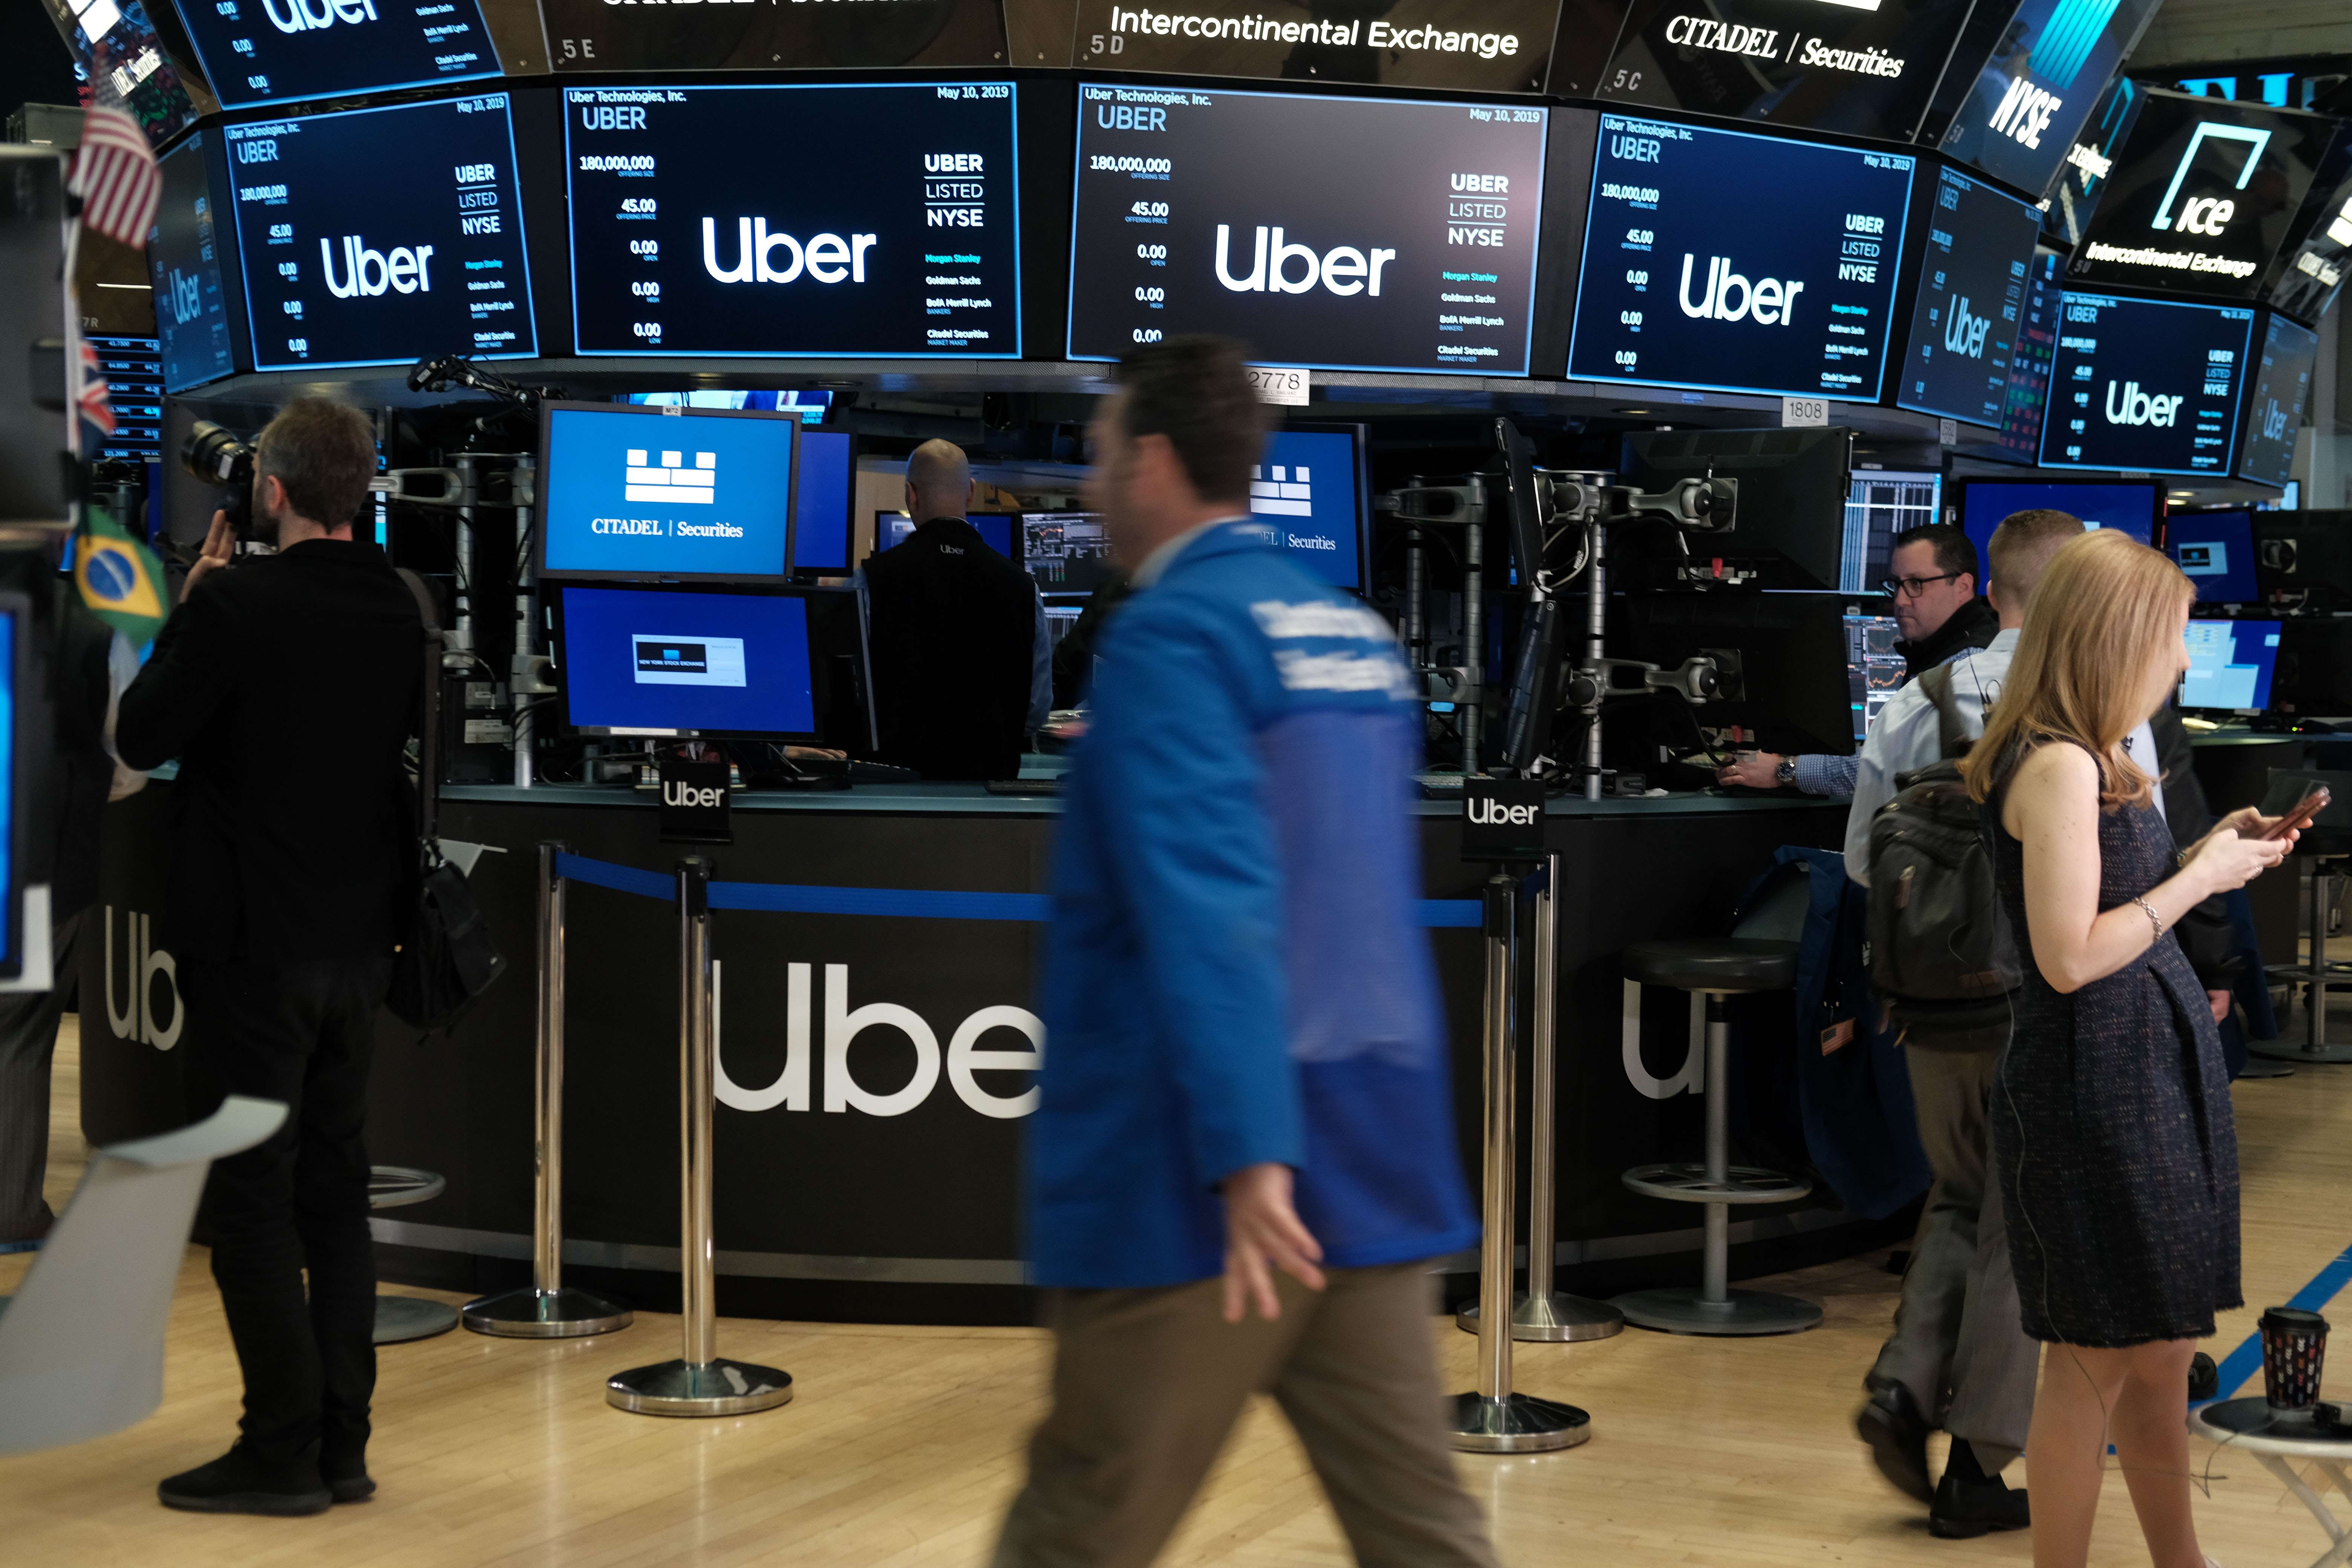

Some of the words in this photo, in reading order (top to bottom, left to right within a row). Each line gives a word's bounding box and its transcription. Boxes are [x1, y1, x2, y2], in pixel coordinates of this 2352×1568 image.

[216, 2, 236, 15] 0.00
[1110, 6, 1360, 46] Intercontinental
[1367, 21, 1518, 59] Exchange
[233, 39, 252, 52] 0.00
[1666, 15, 1779, 58] CITADEL
[1800, 38, 1905, 78] Securities
[248, 76, 267, 89] 0.00
[570, 91, 594, 103] Uber
[596, 90, 666, 103] Technologies,
[668, 90, 686, 102] Inc.
[937, 87, 959, 100] May
[962, 86, 979, 100] 10,
[981, 86, 1008, 98] 2019
[1085, 88, 1112, 100] Uber
[1114, 89, 1189, 106] Technologies,
[1192, 94, 1211, 106] Inc.
[456, 101, 473, 113] May
[473, 100, 485, 112] 10,
[485, 97, 504, 110] 2019
[1989, 76, 2062, 150] NYSE
[582, 106, 647, 130] UBER
[1098, 104, 1167, 132] UBER
[1470, 108, 1492, 122] May
[1494, 110, 1510, 122] 10,
[1513, 110, 1540, 123] 2019
[228, 127, 244, 140] Uber
[243, 123, 287, 138] Technologies,
[288, 122, 300, 134] Inc.
[1604, 118, 1624, 131] Uber
[1626, 121, 1678, 140] Technologies,
[1678, 129, 1693, 141] Inc.
[237, 140, 279, 164] UBER
[1611, 135, 1660, 164] UBER
[579, 156, 654, 171] 180,000,000
[924, 153, 983, 172] UBER
[1090, 156, 1171, 173] 180,000,000
[1864, 155, 1879, 168] May
[1879, 157, 1891, 170] 10,
[1893, 158, 1910, 171] 2019
[455, 164, 496, 184] UBER
[926, 184, 983, 198] LISTED
[1451, 173, 1508, 193] UBER
[240, 184, 286, 201] 180,000,000
[458, 191, 498, 208] LISTED
[1601, 183, 1659, 202] 180,000,000
[621, 199, 656, 213] 45.00
[1132, 202, 1168, 217] 45.00
[1449, 203, 1506, 219] LISTED
[462, 216, 501, 236] NYSE
[927, 209, 983, 227] NYSE
[1845, 213, 1884, 234] UBER
[270, 224, 292, 237] 45.00
[1448, 227, 1504, 247] NYSE
[1626, 229, 1654, 244] 45.00
[630, 240, 657, 254] 0.00
[702, 217, 876, 283] Uber
[1137, 244, 1167, 259] 0.00
[1842, 240, 1880, 257] LISTED
[320, 235, 434, 299] Uber
[925, 254, 953, 264] Morgan
[954, 254, 980, 264] Stanley
[1215, 224, 1395, 296] Uber
[2086, 242, 2194, 270] Intercontinental
[2190, 253, 2256, 279] Exchange
[278, 262, 297, 276] 0.00
[1442, 271, 1470, 282] Morgan
[1471, 273, 1498, 283] Stanley
[1838, 263, 1877, 283] NYSE
[926, 276, 959, 285] Goldman
[959, 276, 981, 285] Sachs
[1627, 270, 1648, 285] 0.00
[168, 267, 202, 325] Uber
[632, 282, 659, 296] 0.00
[1135, 287, 1164, 302] 0.00
[1679, 253, 1804, 326] Uber
[926, 298, 945, 307] BofA
[946, 298, 968, 307] Merrill
[969, 299, 991, 308] Lynch
[1441, 293, 1474, 302] Goldman
[1474, 294, 1496, 304] Sachs
[283, 301, 302, 315] 0.00
[2067, 305, 2098, 323] UBER
[1439, 315, 1458, 324] BofA
[1459, 316, 1482, 325] Merrill
[1482, 317, 1504, 327] Lynch
[1621, 311, 1642, 326] 0.00
[1945, 293, 1991, 359] Uber
[634, 323, 661, 337] 0.00
[927, 329, 952, 338] Citadel
[954, 329, 988, 338] Securities
[1133, 329, 1162, 343] 0.00
[288, 338, 307, 352] 0.00
[1437, 345, 1463, 355] Citadel
[1464, 346, 1498, 356] Securities
[1615, 351, 1637, 365] 0.00
[2208, 349, 2234, 363] UBER
[1249, 372, 1299, 389] 2778
[2206, 368, 2231, 379] LISTED
[2203, 383, 2229, 396] NYSE
[1790, 402, 1822, 418] 1808
[2106, 380, 2184, 427] Uber
[591, 518, 662, 536] CITADEL
[677, 521, 743, 538] Securities
[1289, 533, 1335, 550] Securities
[940, 544, 965, 556] Uber
[664, 781, 724, 807] Uber
[1468, 798, 1539, 825] Uber
[106, 905, 184, 1050] Ub
[713, 960, 1048, 1119] Ube
